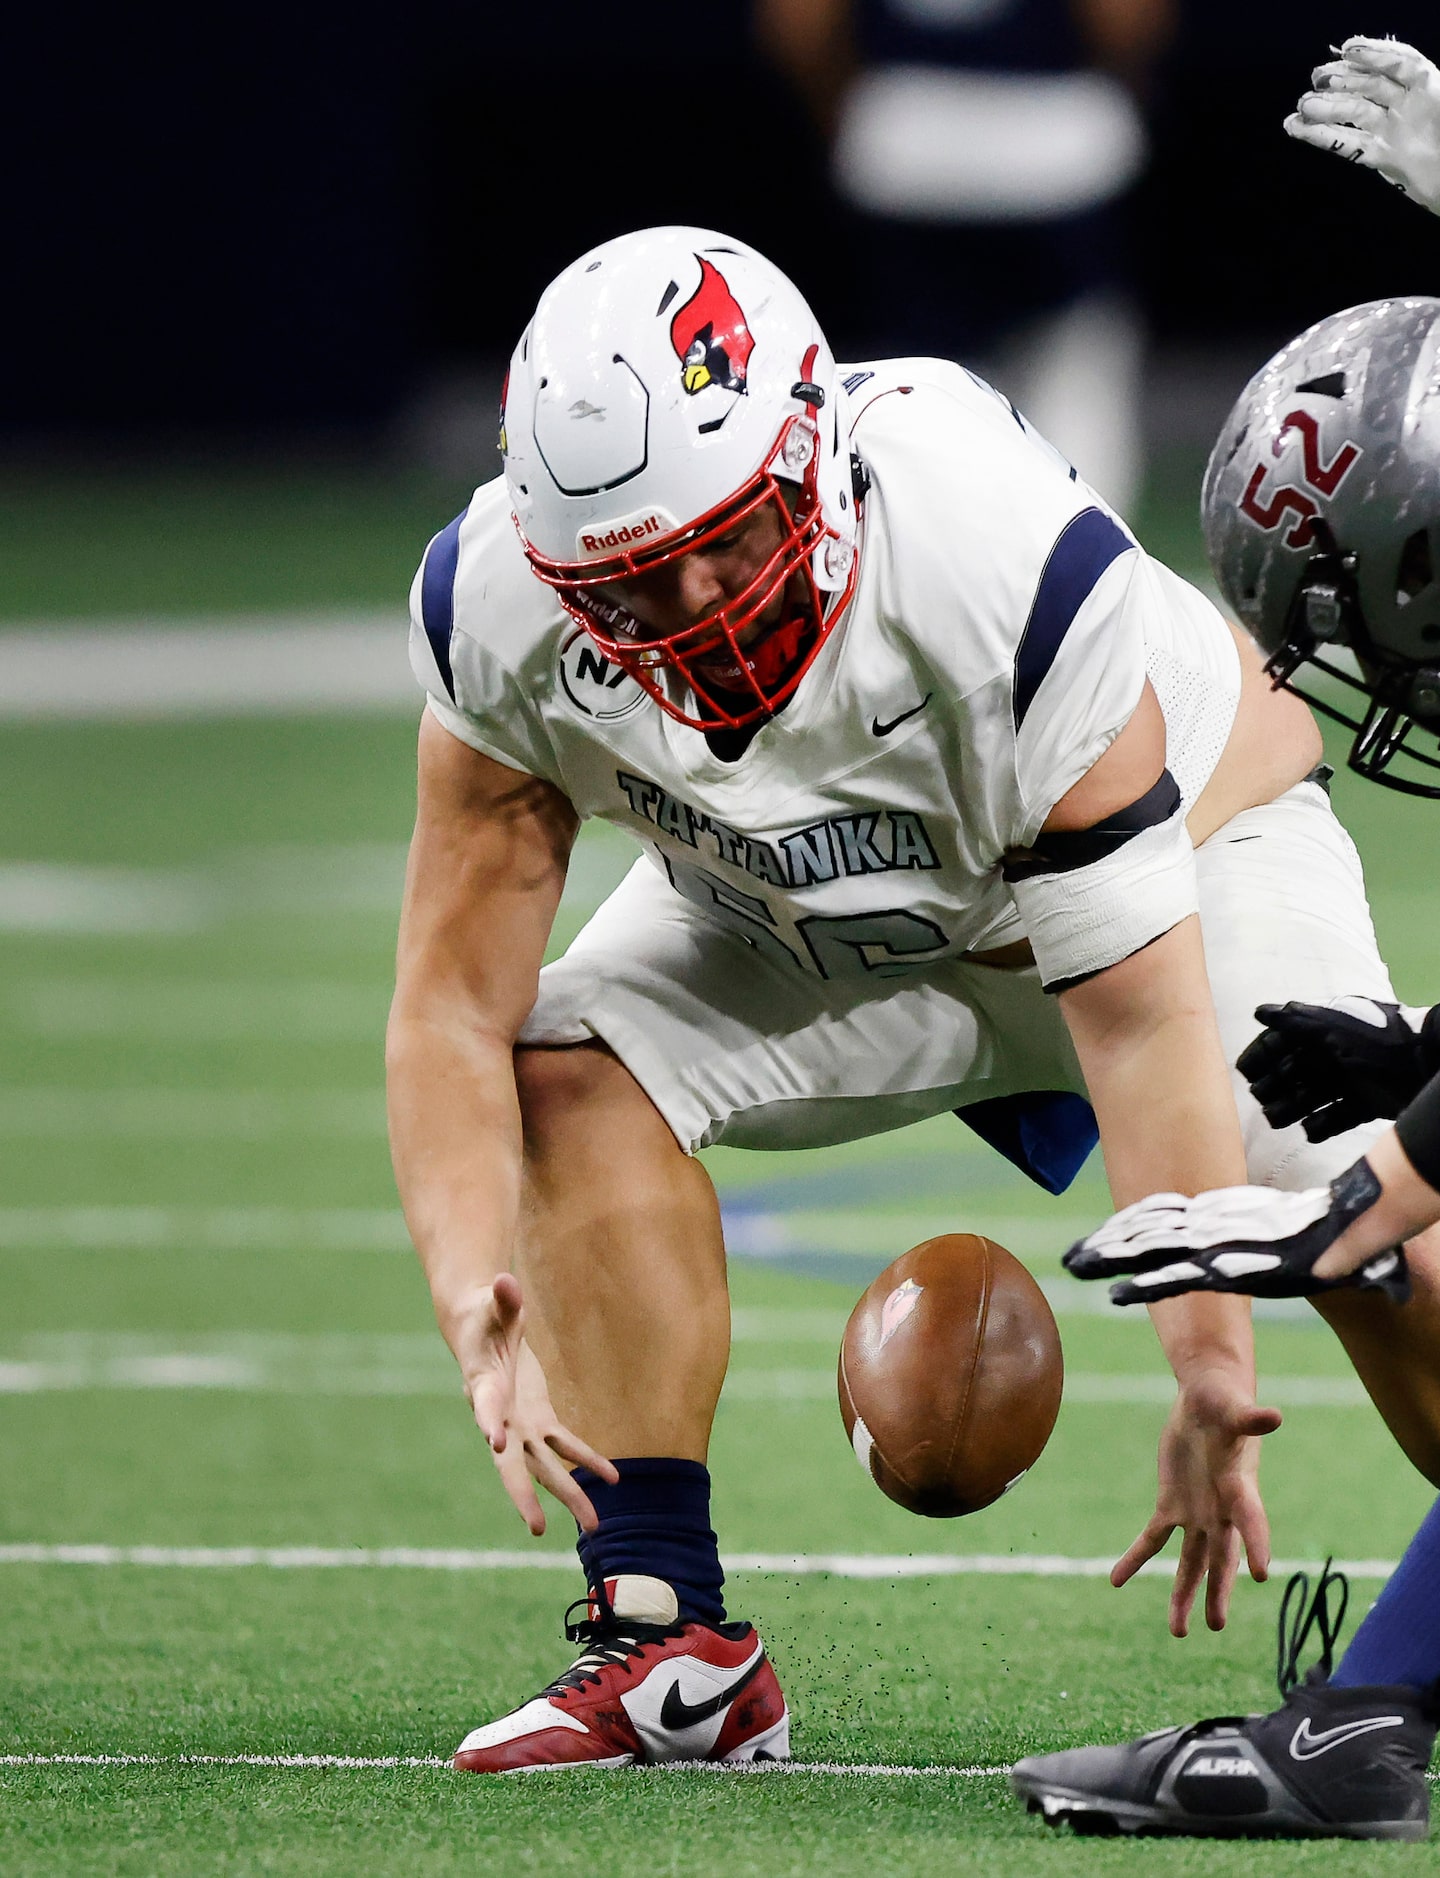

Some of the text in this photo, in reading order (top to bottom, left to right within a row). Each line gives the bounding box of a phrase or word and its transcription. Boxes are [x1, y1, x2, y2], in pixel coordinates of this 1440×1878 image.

[1237, 409, 1364, 552] 52
[581, 515, 660, 552] Riddell
[1183, 1758, 1260, 1776] ALPHA
